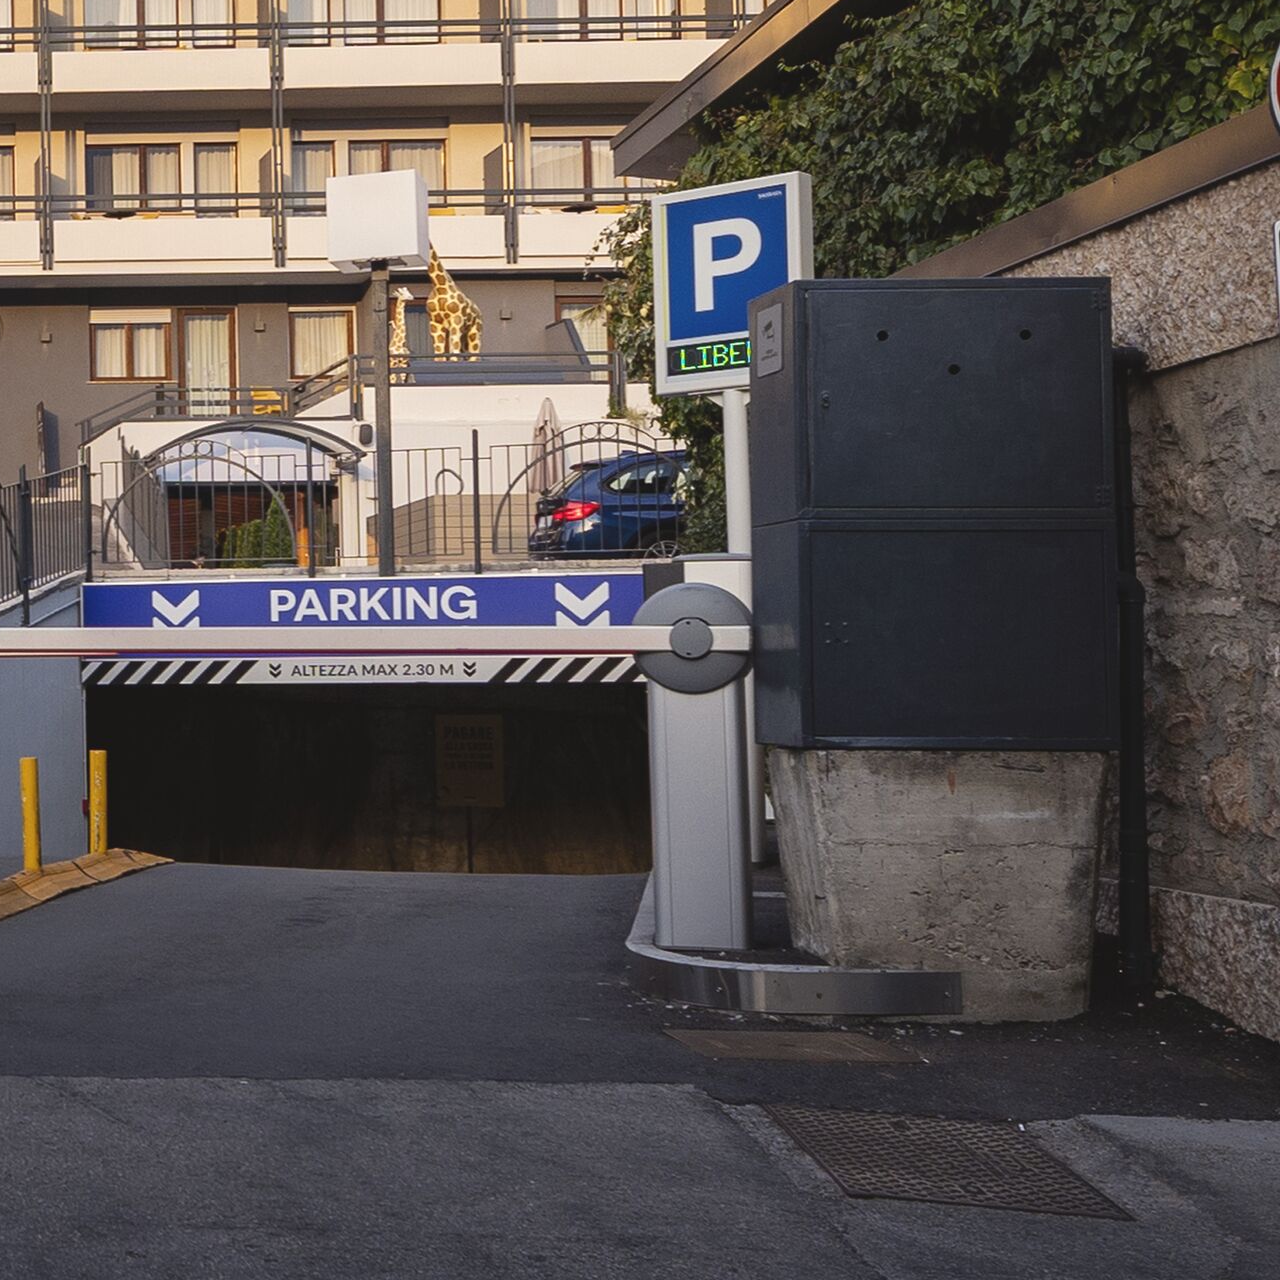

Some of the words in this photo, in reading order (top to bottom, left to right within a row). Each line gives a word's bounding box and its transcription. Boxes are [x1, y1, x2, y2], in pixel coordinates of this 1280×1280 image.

[693, 217, 762, 313] P
[680, 340, 751, 371] LIBE
[269, 585, 478, 622] PARKING
[290, 664, 358, 677] ALTEZZA
[361, 664, 398, 676] MAX
[402, 663, 435, 676] 2.30
[439, 663, 454, 675] M
